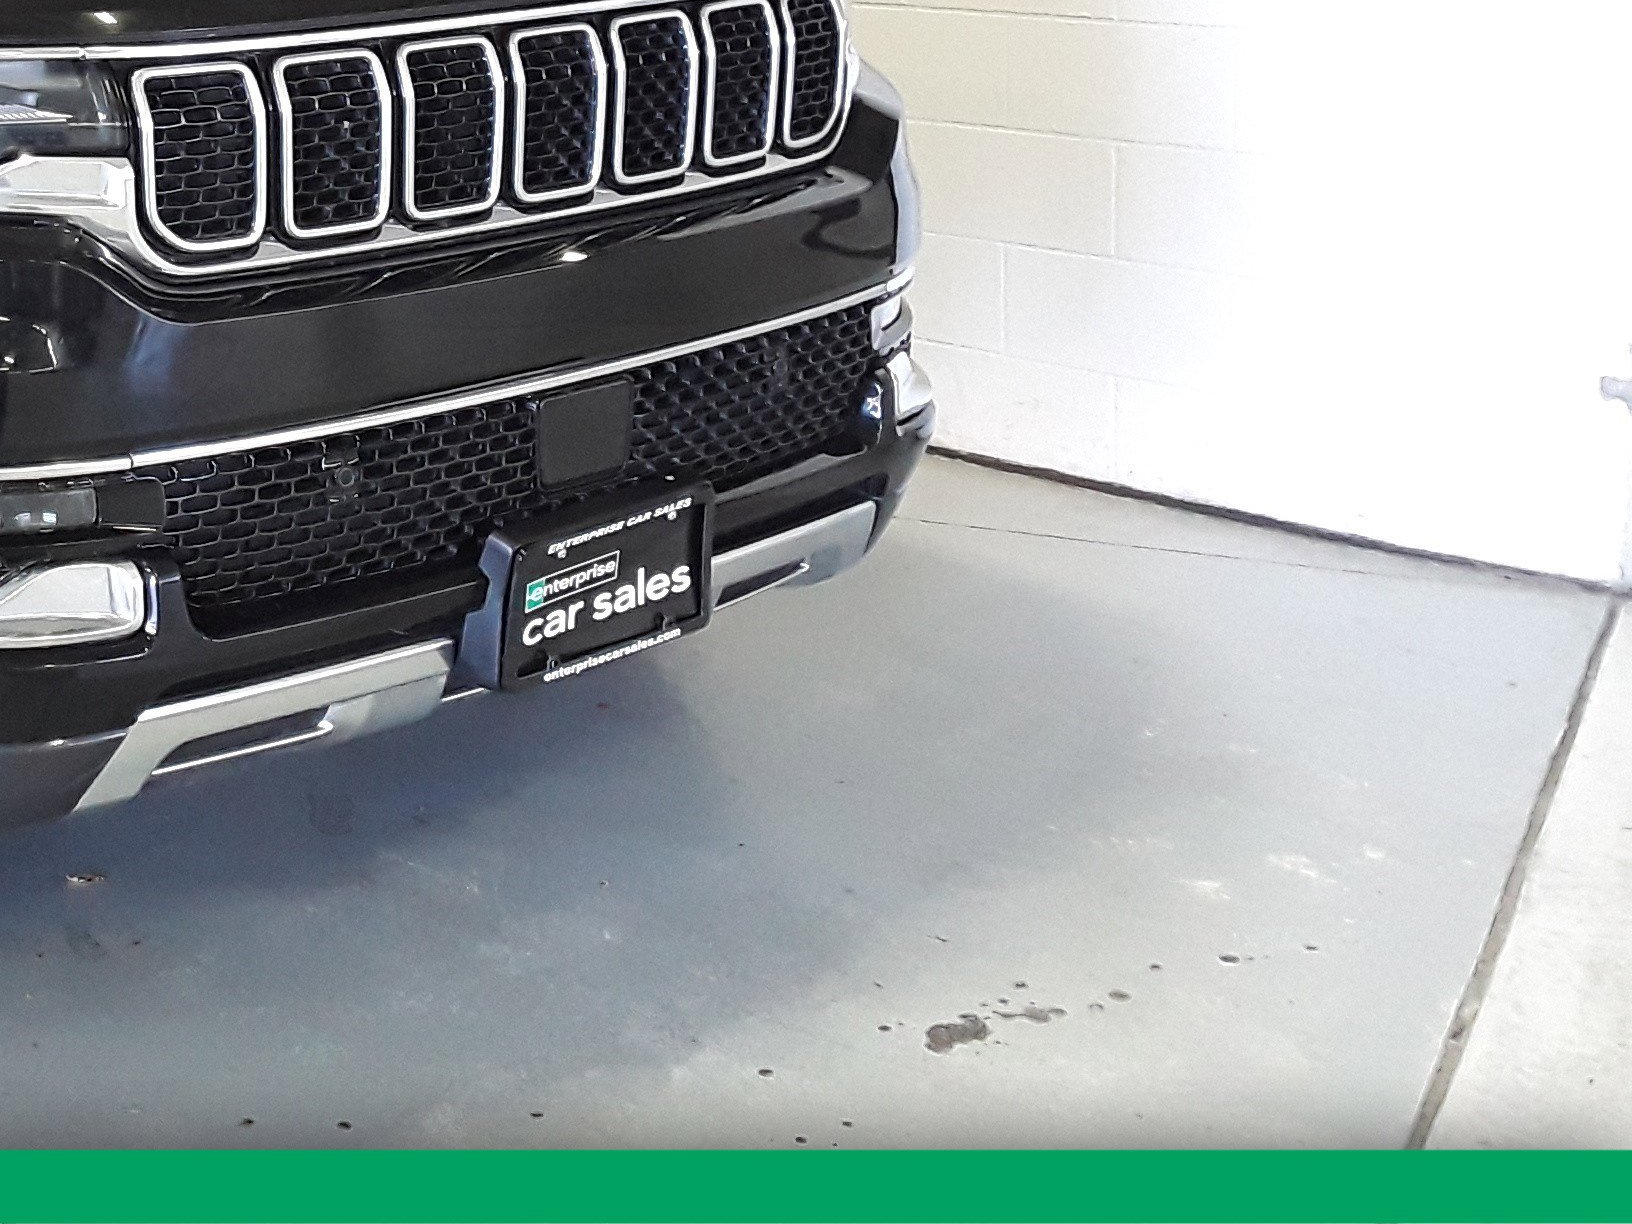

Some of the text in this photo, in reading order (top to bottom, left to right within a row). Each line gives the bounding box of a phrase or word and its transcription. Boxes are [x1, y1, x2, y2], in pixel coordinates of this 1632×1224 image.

[547, 497, 692, 555] ENTERPRISE CAR SALES
[521, 565, 691, 646] car sales
[528, 558, 616, 602] enterprise
[543, 627, 681, 682] enterprisecarsales.com
